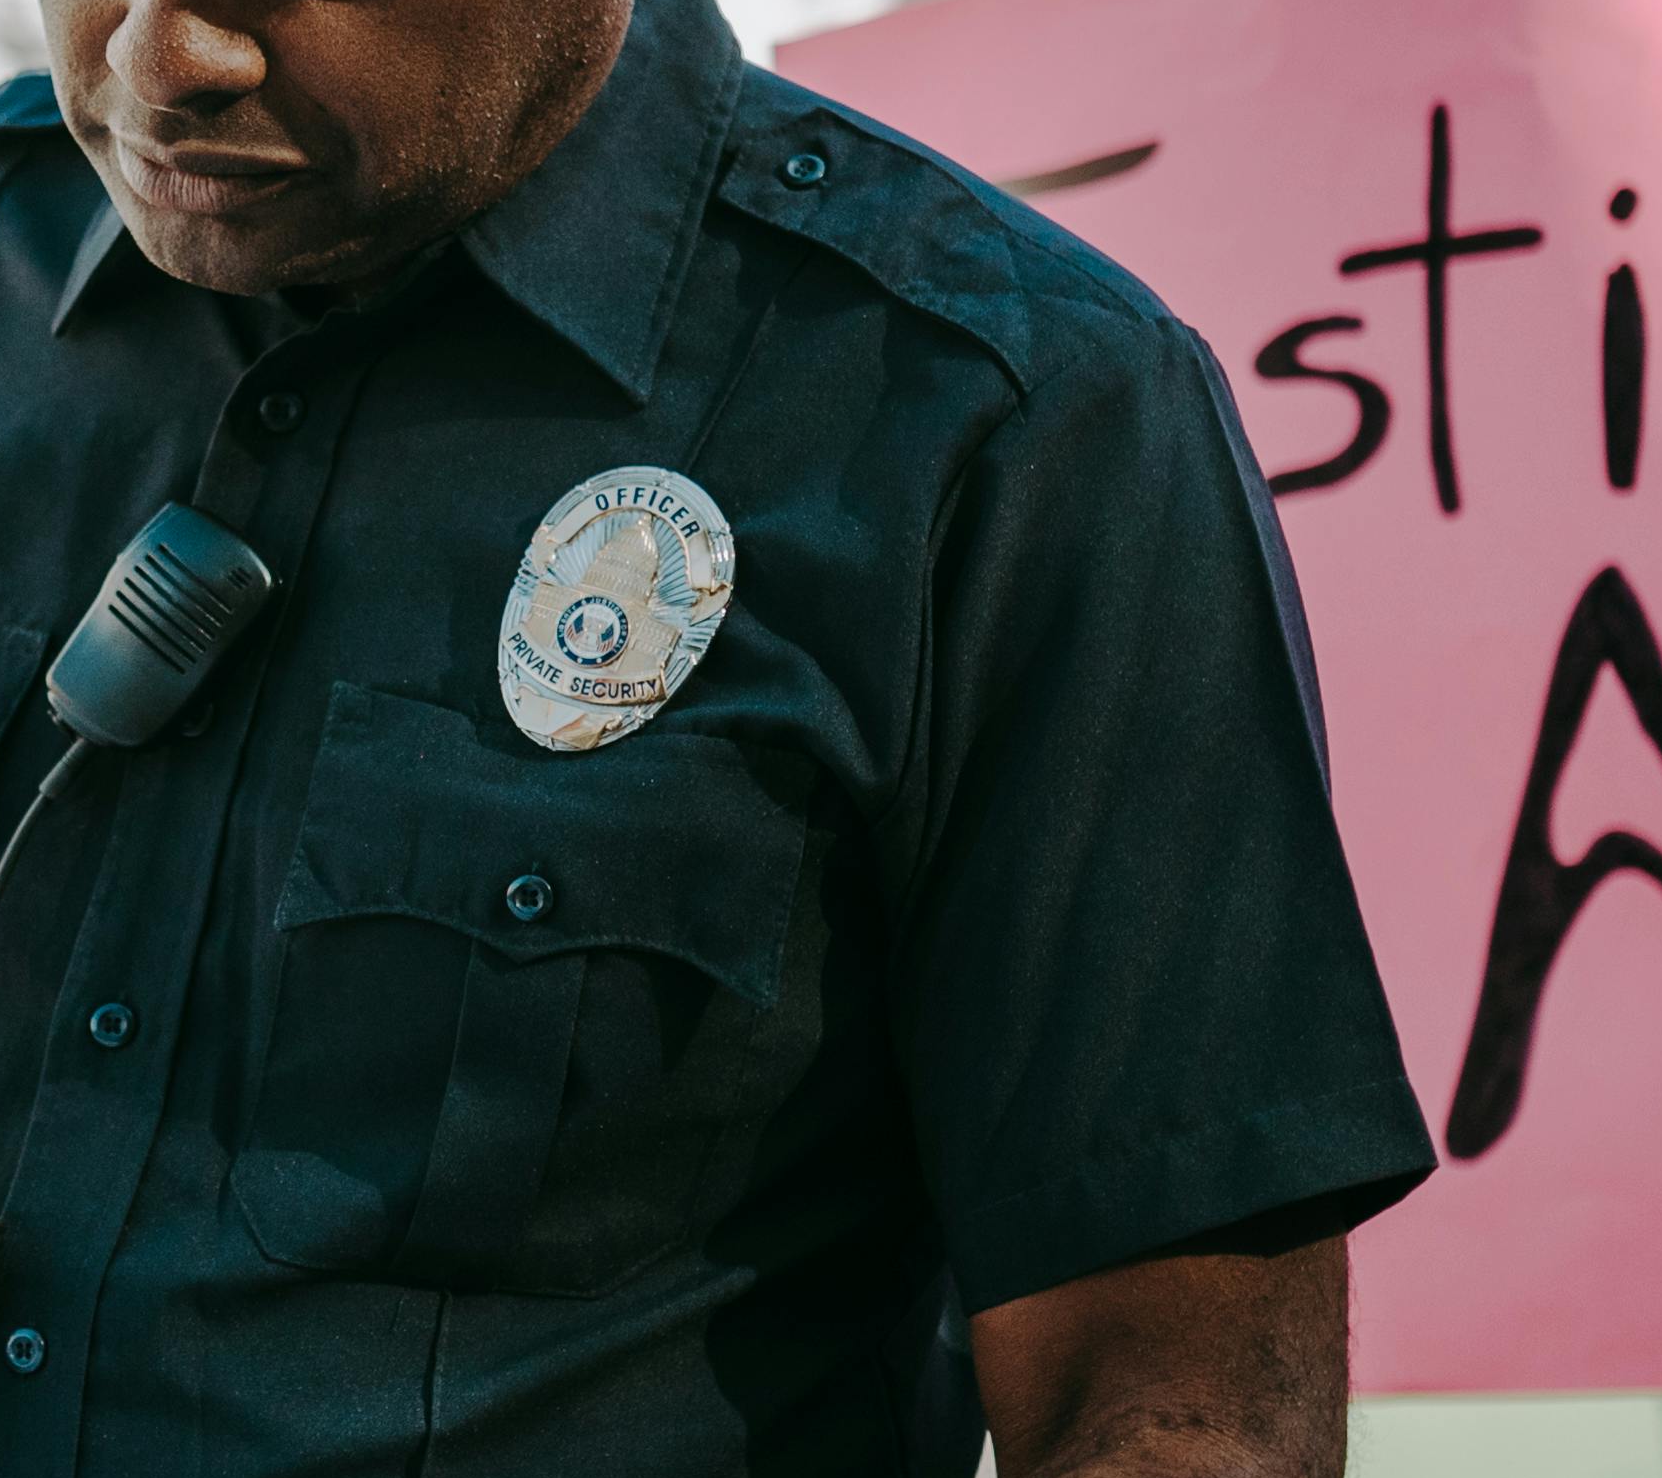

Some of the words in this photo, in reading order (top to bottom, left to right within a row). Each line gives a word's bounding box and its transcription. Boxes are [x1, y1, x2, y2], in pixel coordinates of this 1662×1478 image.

[595, 486, 701, 539] OFFICER
[507, 632, 563, 685] PRIVATE
[570, 677, 658, 700] SECURITY
